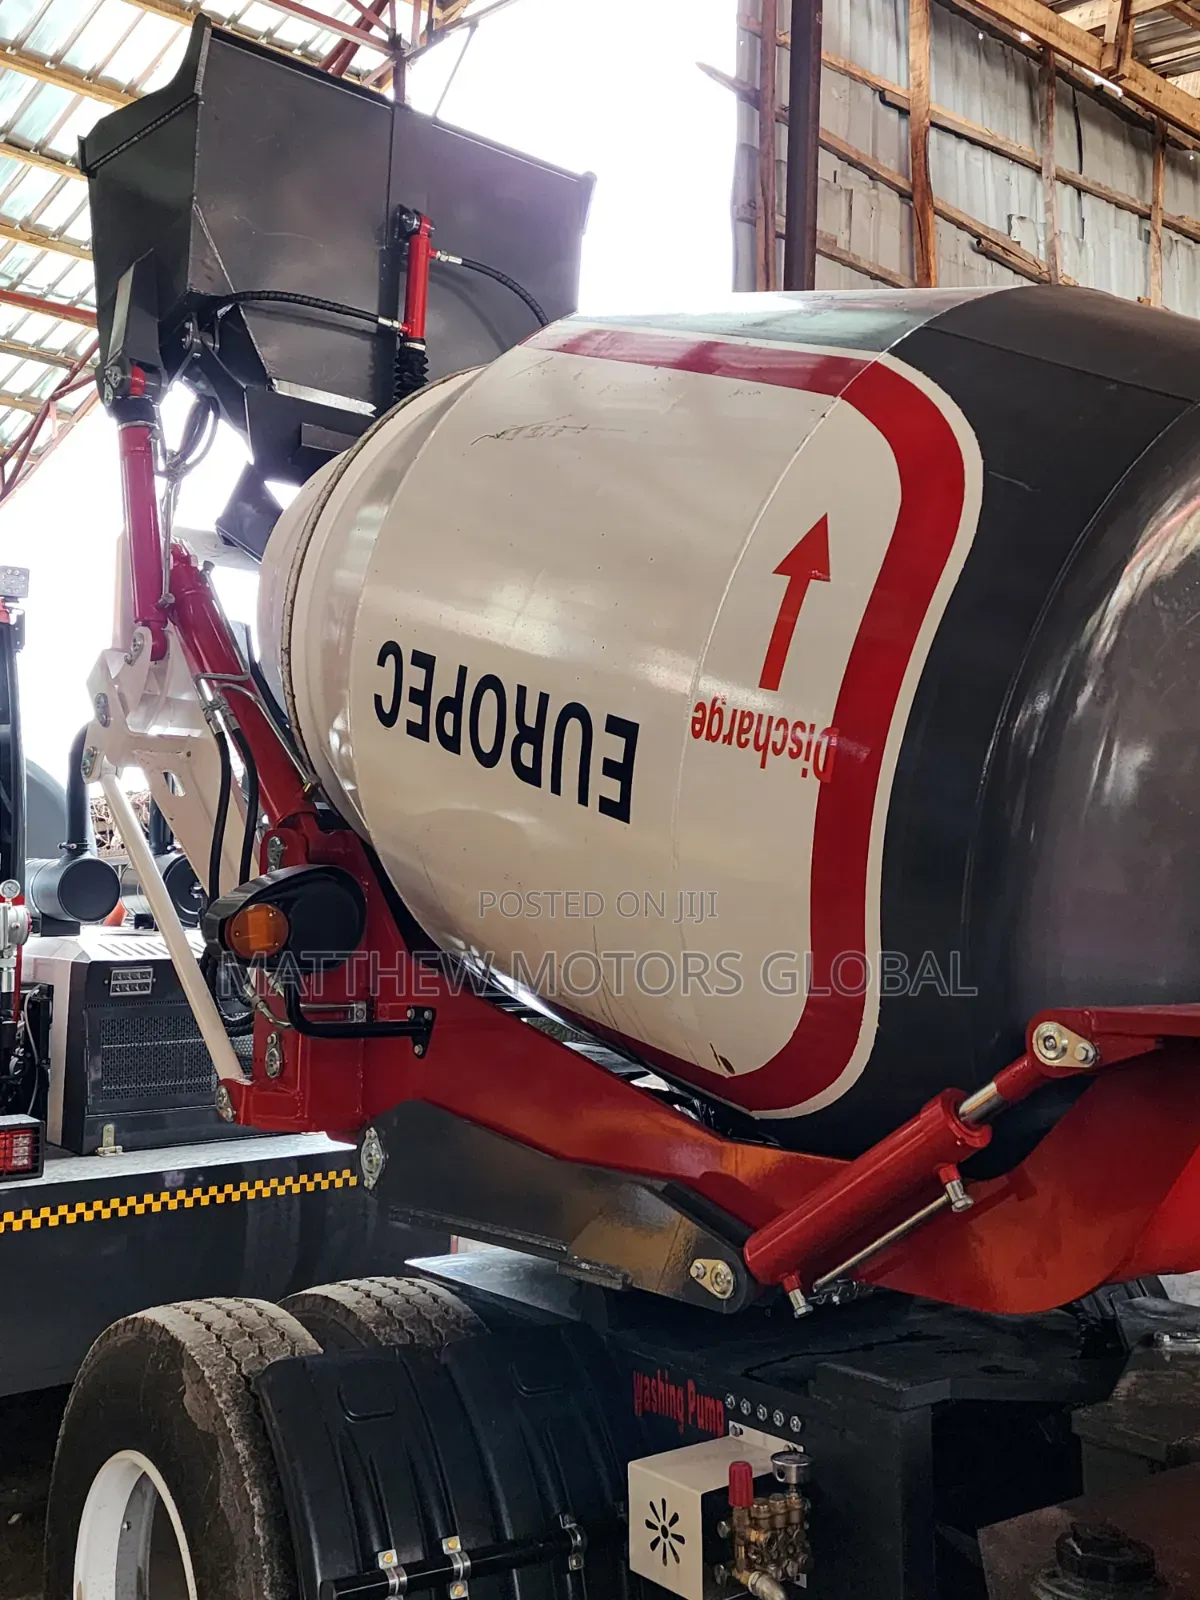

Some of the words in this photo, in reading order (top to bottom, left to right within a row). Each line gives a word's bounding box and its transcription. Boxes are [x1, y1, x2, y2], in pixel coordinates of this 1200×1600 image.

[374, 640, 639, 824] EUROPEC
[691, 696, 839, 783] Discharge
[687, 1379, 725, 1439] Pump
